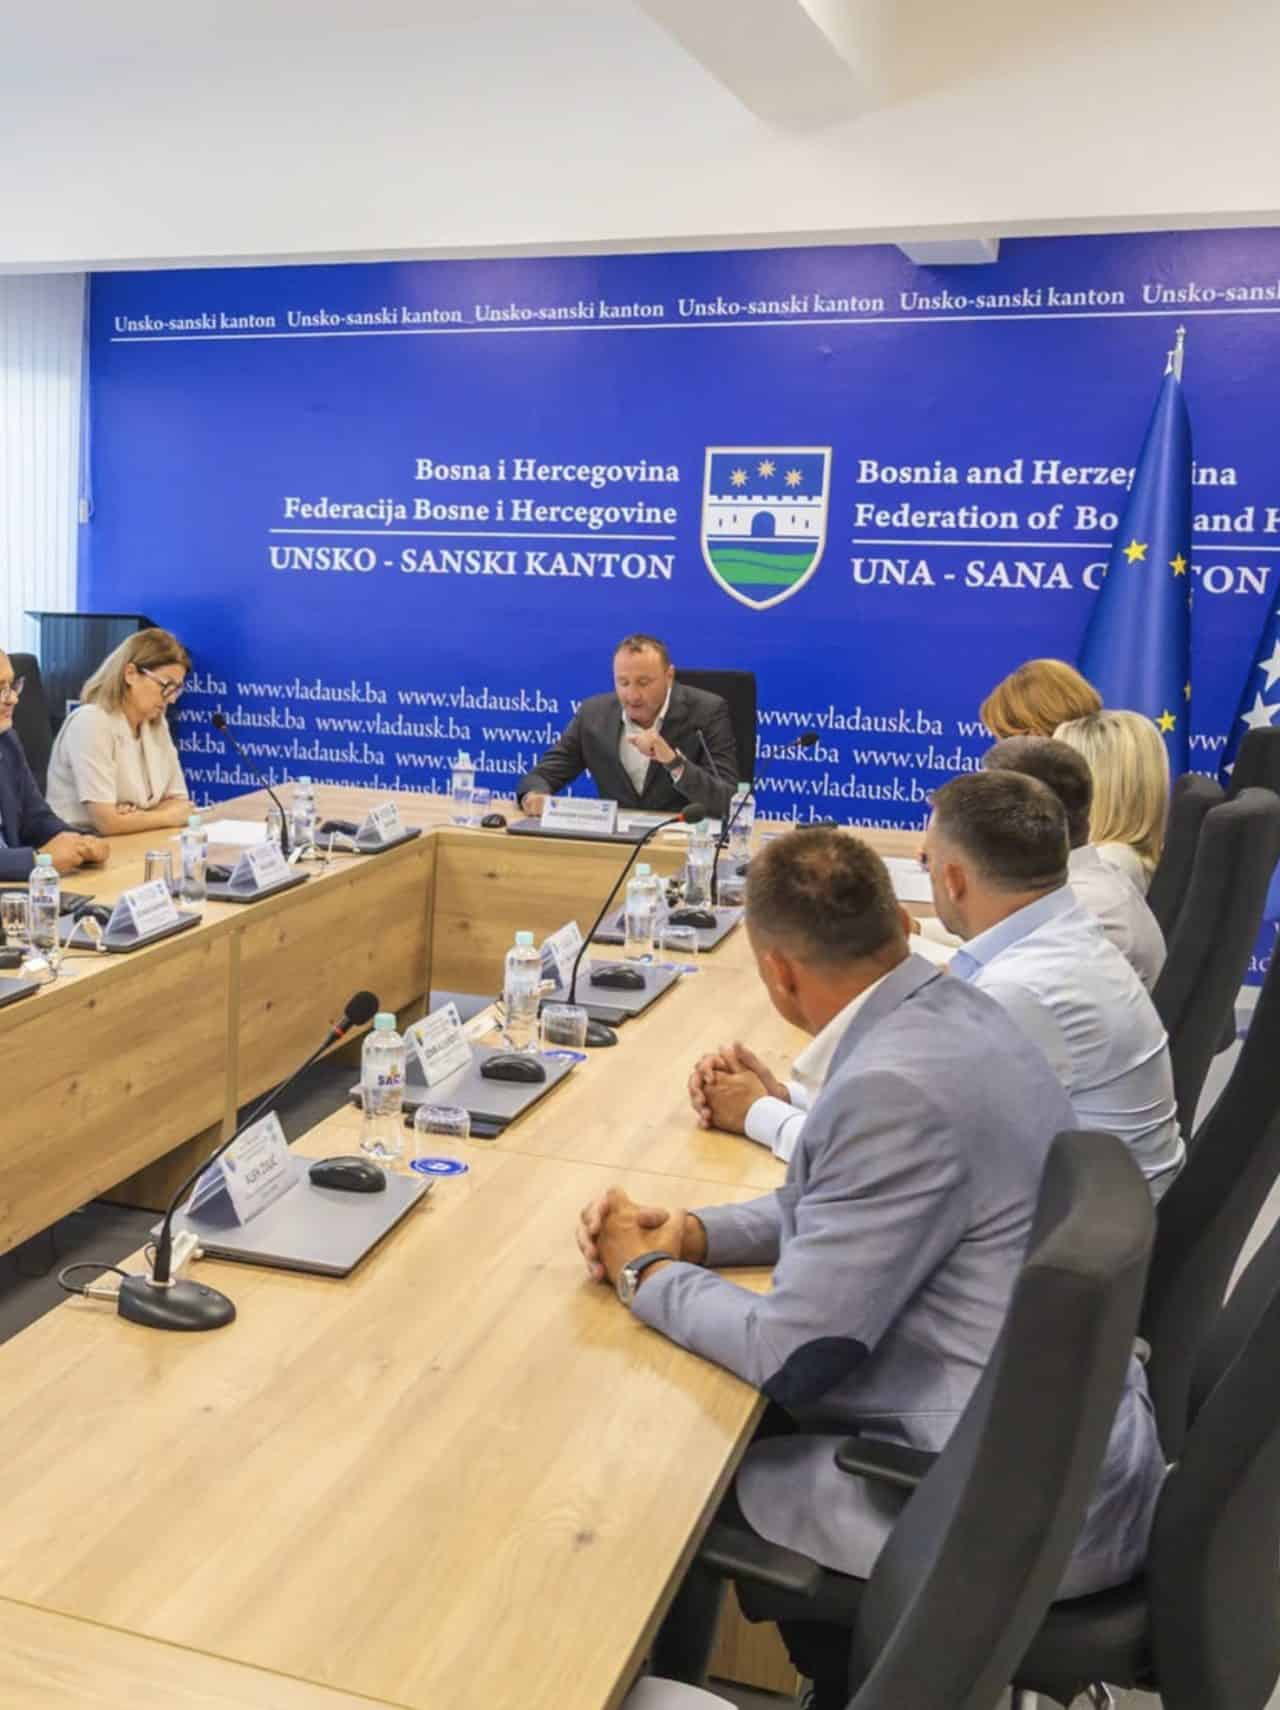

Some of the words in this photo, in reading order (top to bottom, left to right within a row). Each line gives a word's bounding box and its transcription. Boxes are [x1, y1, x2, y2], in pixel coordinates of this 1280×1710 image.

[115, 312, 217, 332] Unsko-sanski
[220, 312, 276, 329] kanton
[287, 307, 398, 327] Unsko-sanski
[401, 306, 462, 324] kanton
[475, 301, 595, 322] Unsko-sanski
[599, 300, 664, 319] kanton
[679, 296, 809, 317] Unsko-sanski
[813, 294, 884, 313] kanton
[899, 289, 1042, 311] Unsko-sanski
[1047, 287, 1125, 307] kanton
[415, 458, 491, 481] Bosna
[497, 459, 506, 481] i
[512, 458, 680, 489] Hercegovina
[856, 459, 959, 484] Bosnia
[966, 458, 1023, 485] and
[284, 497, 407, 526] Federacija
[413, 498, 490, 521] Bosne
[495, 499, 504, 521] i
[511, 499, 677, 530] Hercegovine
[854, 503, 1019, 529] Federation
[1027, 503, 1061, 530] of
[1193, 506, 1255, 533] and
[269, 546, 377, 572] UNSKO
[400, 548, 517, 575] SANSKI
[524, 551, 675, 580] KANTON
[851, 558, 935, 586] UNA
[965, 560, 1073, 589] SANA
[237, 678, 387, 704] www.vladausk.ba
[397, 686, 559, 713] www.vladausk.ba
[315, 712, 471, 740] www.vladausk.ba
[756, 705, 943, 736] www.vladausk.ba
